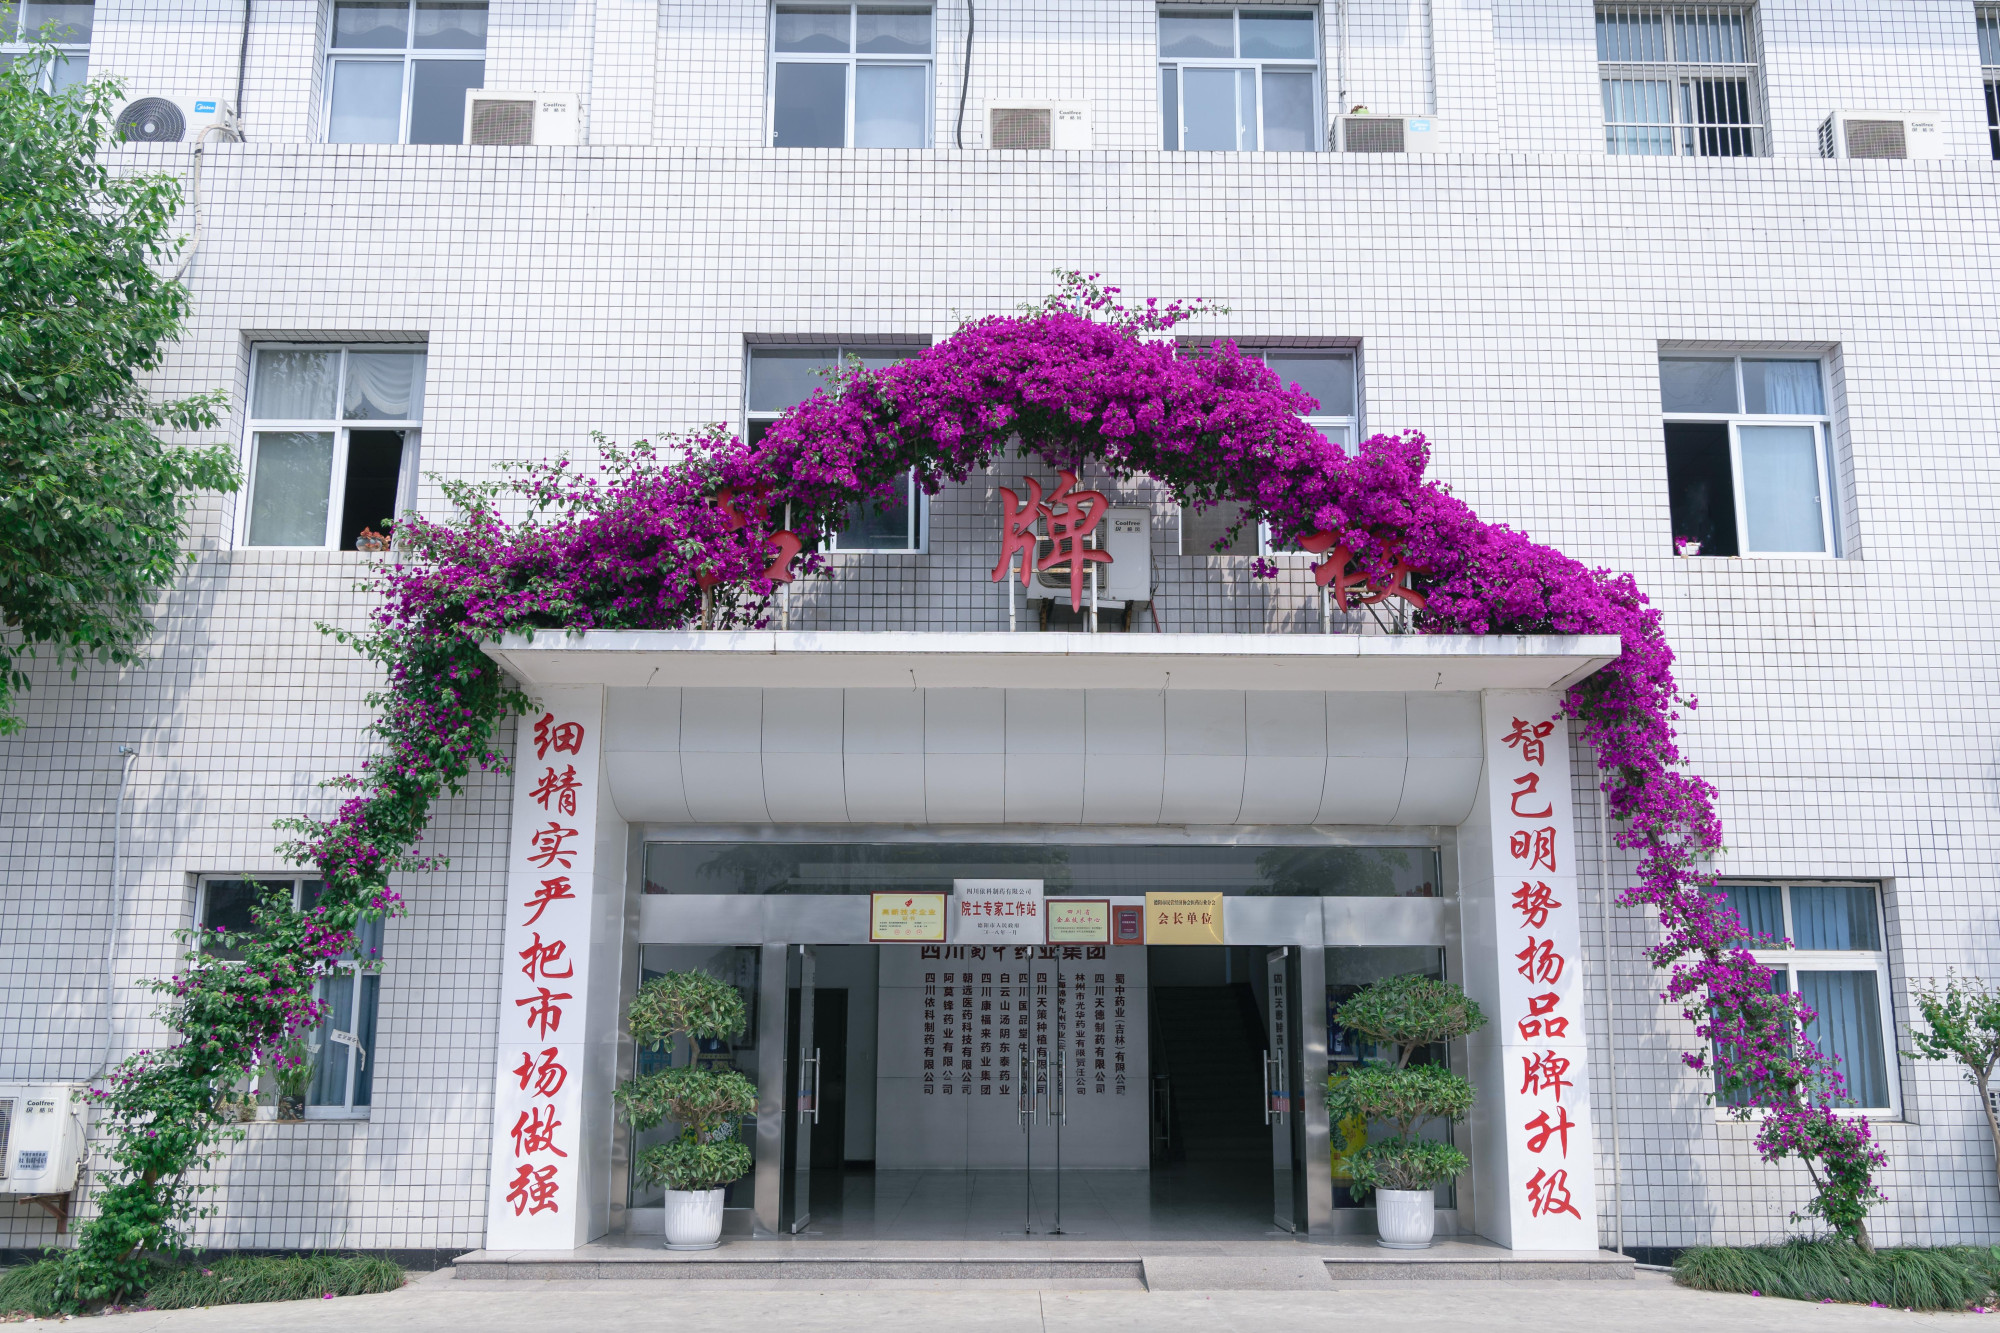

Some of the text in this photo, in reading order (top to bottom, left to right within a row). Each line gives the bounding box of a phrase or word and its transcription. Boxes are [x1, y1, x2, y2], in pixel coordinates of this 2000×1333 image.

[506, 712, 584, 1217] 细精实严把市场做强
[961, 900, 1037, 917] 院士专家工作站
[1056, 916, 1101, 924] 企业技术中心
[1158, 912, 1213, 925] 会长单位
[1501, 716, 1581, 1220] 智己明势扬品牌升级
[924, 972, 936, 1095] 四川依科制药有限公司
[961, 972, 973, 1095] 朝远医药科技有限公司
[980, 972, 992, 1095] 四川康福来药业集团
[999, 972, 1011, 1095] 白云山汤阴东泰药业
[1036, 972, 1048, 1095] 四川天策种植有限公司
[1075, 972, 1086, 1096] 林州市光华药业有限责任公司
[1094, 972, 1106, 1095] 四川天德制药有限公司
